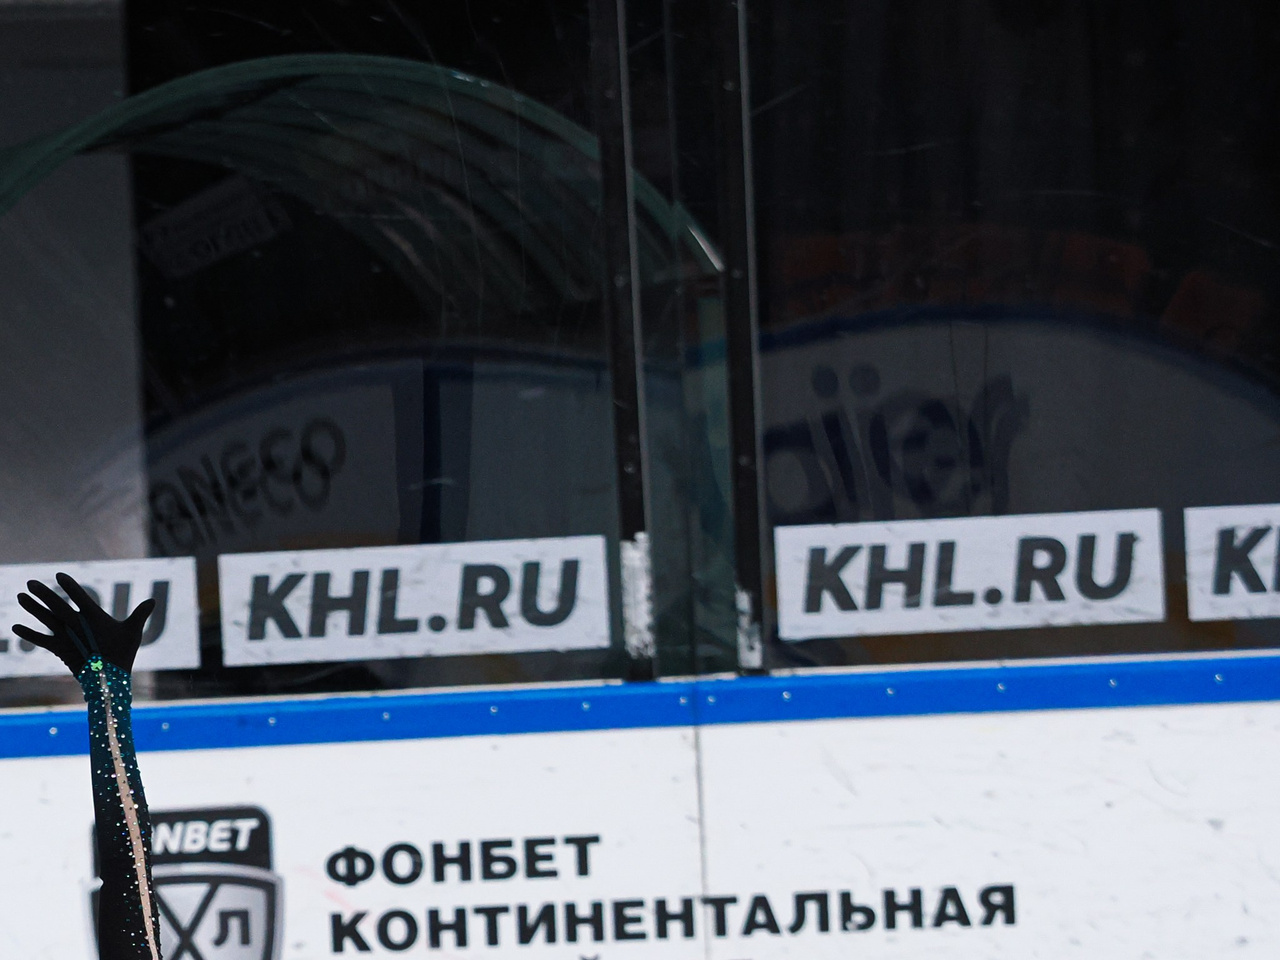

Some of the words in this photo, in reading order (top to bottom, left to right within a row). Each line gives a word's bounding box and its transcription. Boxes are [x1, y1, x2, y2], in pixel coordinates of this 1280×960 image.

[805, 533, 1137, 613] KHL.RU
[1213, 525, 1280, 595] K
[248, 560, 579, 640] KHL.RU
[151, 818, 260, 855] NBET
[326, 835, 600, 886] ФОНБЕТ
[330, 884, 1017, 953] КОНТИНЕНТАЛЬНАЯ
